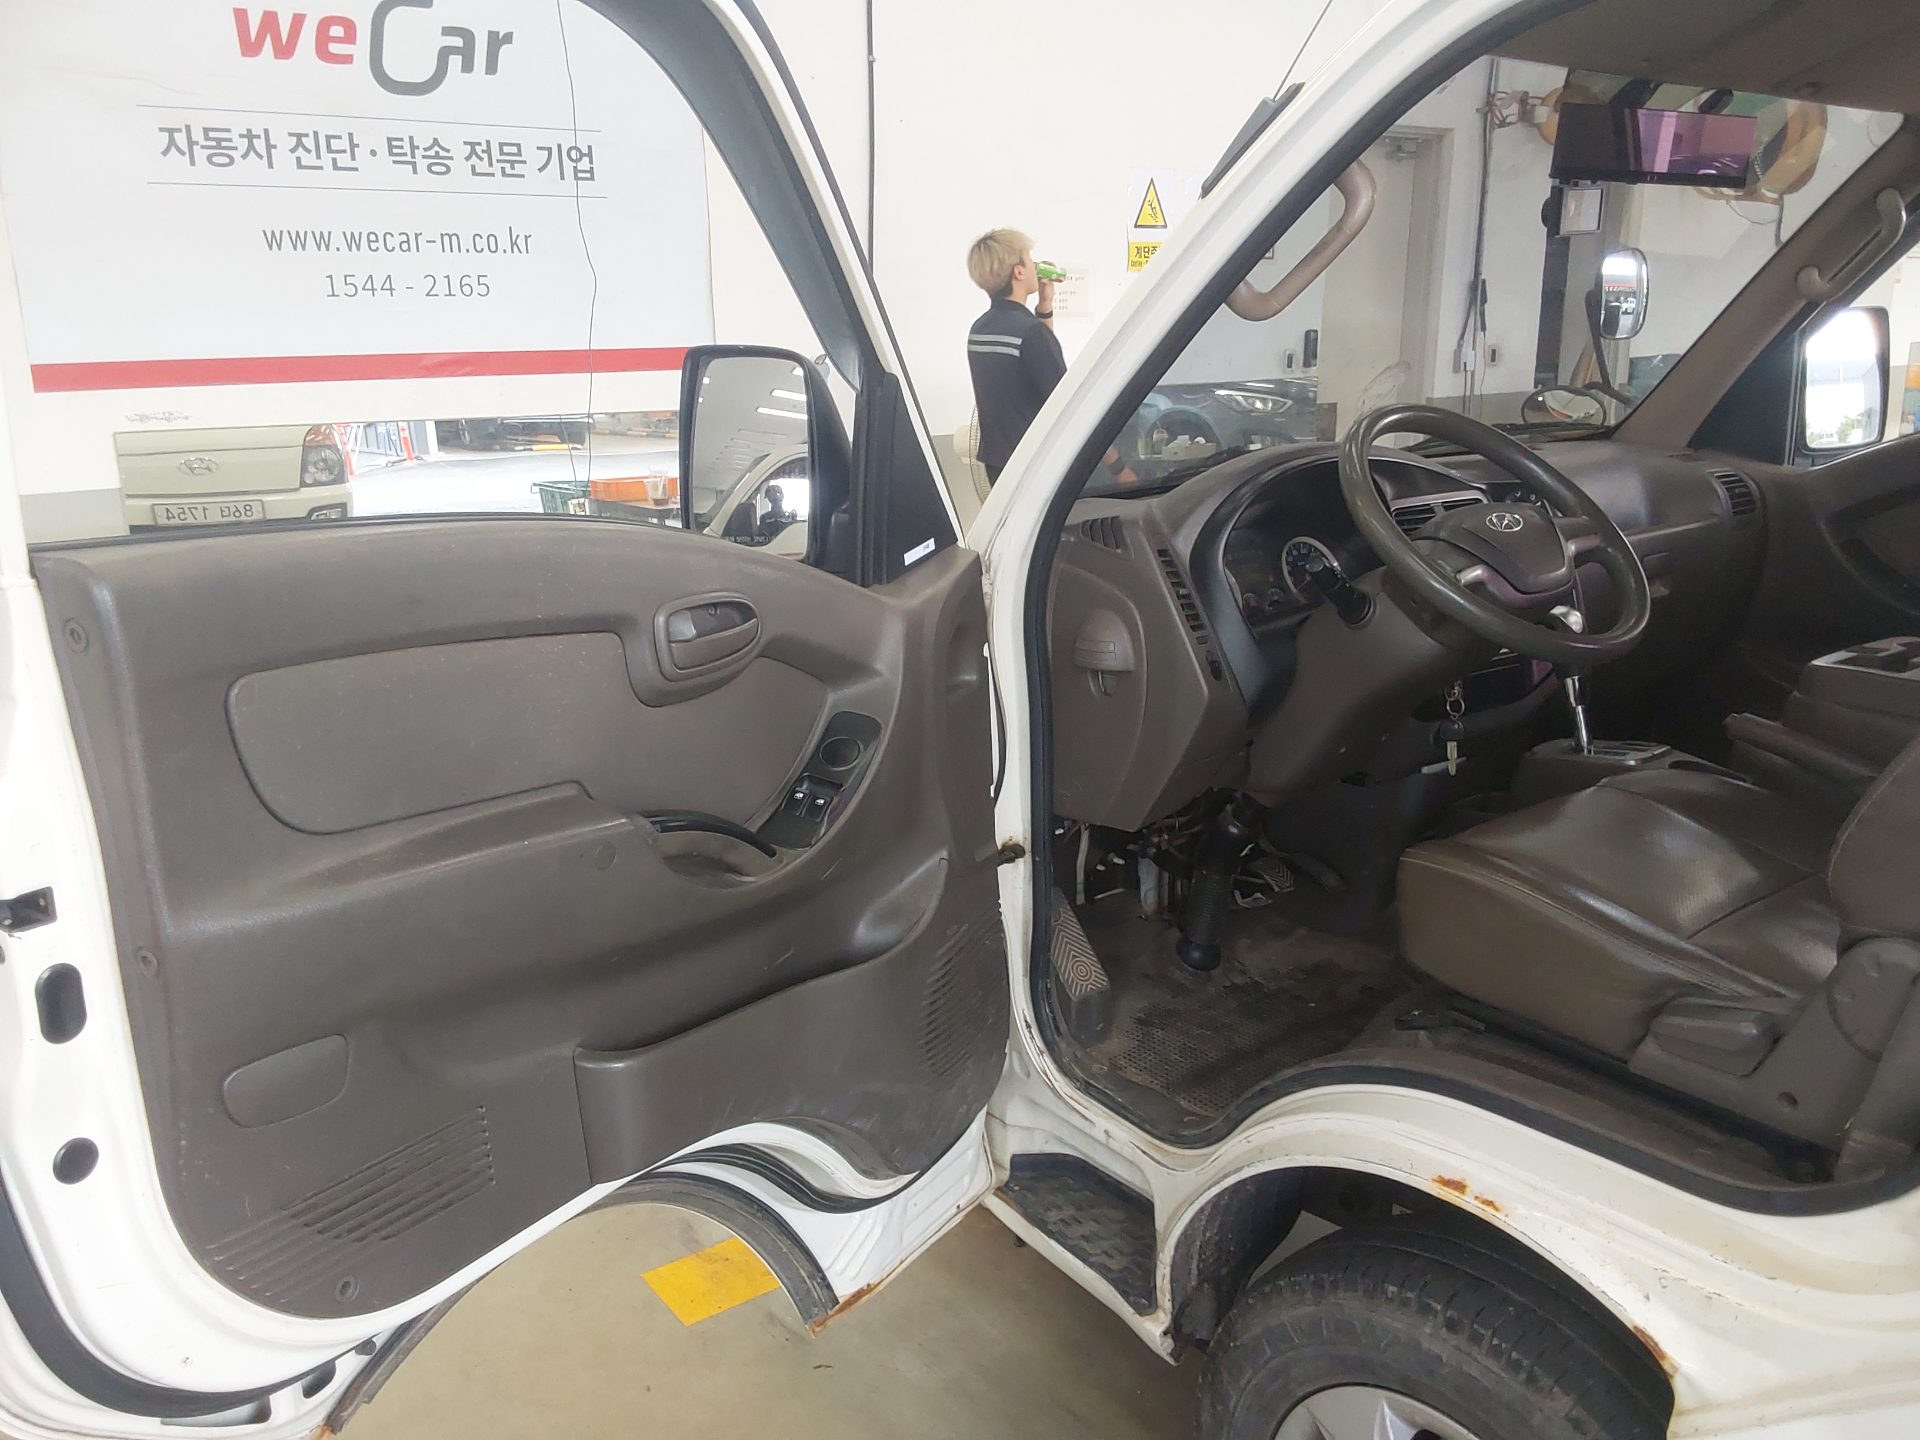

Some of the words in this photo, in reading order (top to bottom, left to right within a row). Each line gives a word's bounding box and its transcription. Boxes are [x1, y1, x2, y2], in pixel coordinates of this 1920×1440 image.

[158, 124, 278, 170] 자동차
[462, 139, 528, 180] 전문
[536, 143, 597, 182] 기업
[261, 225, 532, 255] www.wecar-m.co.kr
